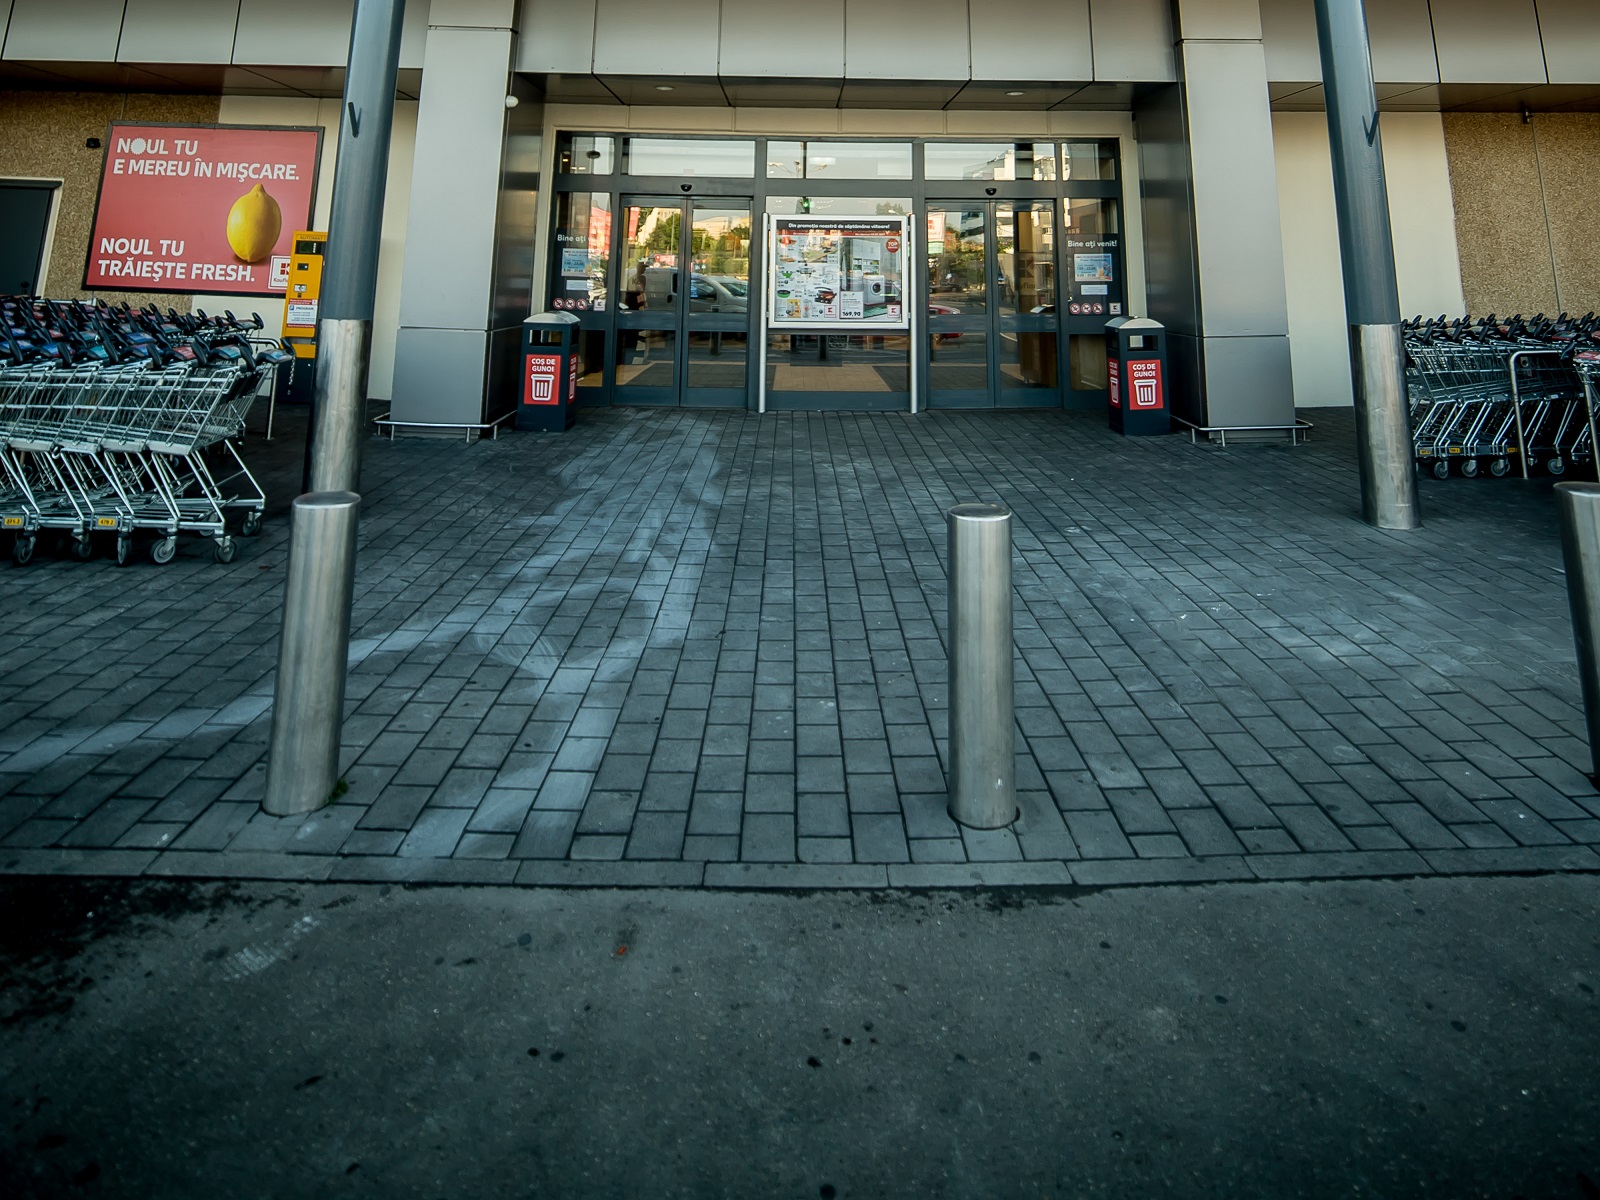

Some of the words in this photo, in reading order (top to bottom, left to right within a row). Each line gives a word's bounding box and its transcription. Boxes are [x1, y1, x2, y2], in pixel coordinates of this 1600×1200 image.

[174, 139, 198, 156] TU
[113, 158, 125, 175] E
[127, 159, 190, 177] MEREU
[193, 158, 212, 178] ÎN
[100, 237, 153, 256] NOUL
[159, 239, 185, 256] TU
[557, 234, 574, 242] Bine
[190, 263, 255, 282] FRESH.
